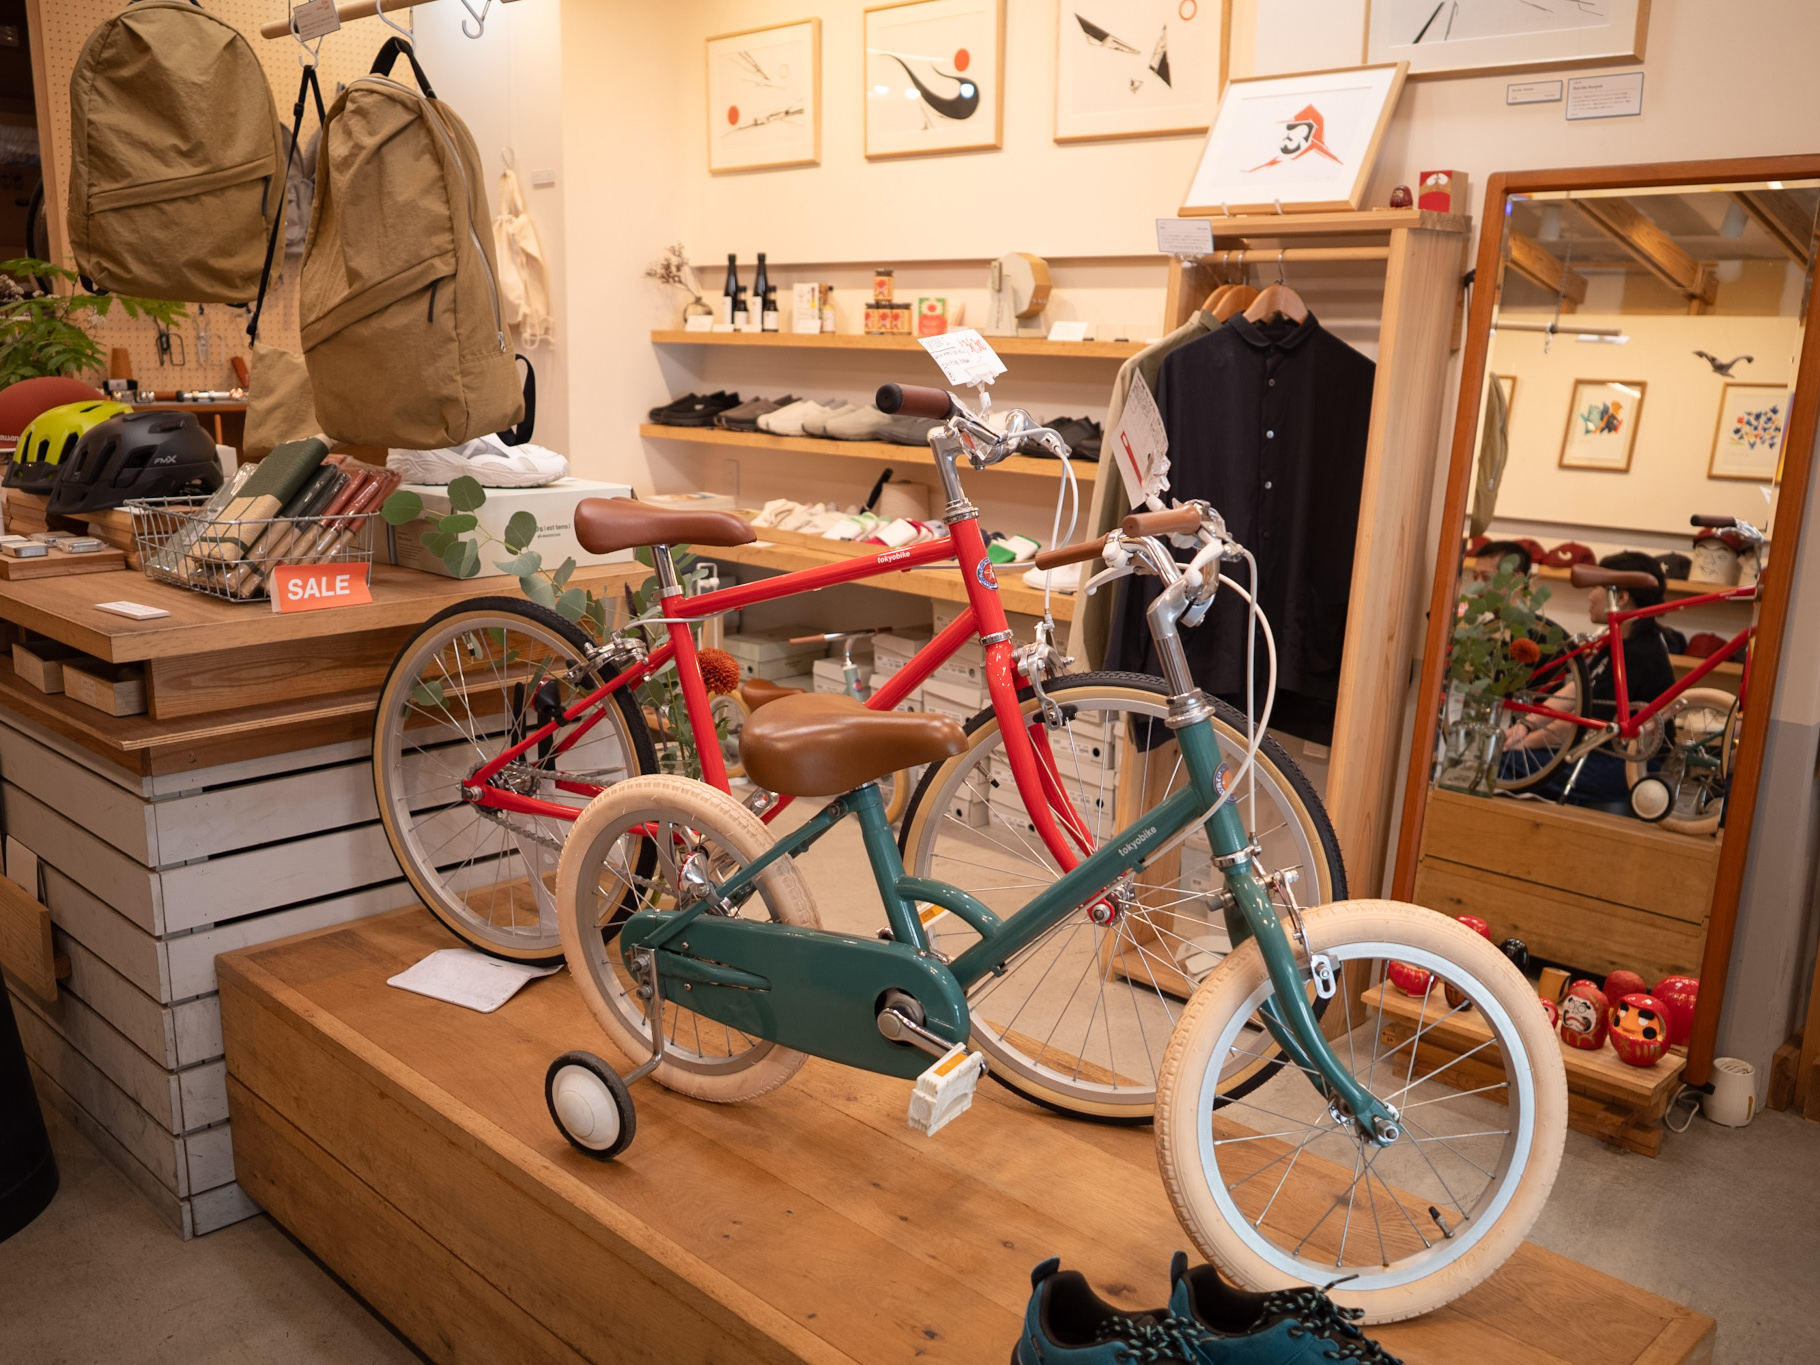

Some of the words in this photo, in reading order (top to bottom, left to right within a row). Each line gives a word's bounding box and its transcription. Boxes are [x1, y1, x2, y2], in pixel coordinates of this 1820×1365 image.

[877, 550, 911, 564] tokyobike
[287, 574, 351, 601] SALE
[1117, 825, 1158, 857] tokyobike
